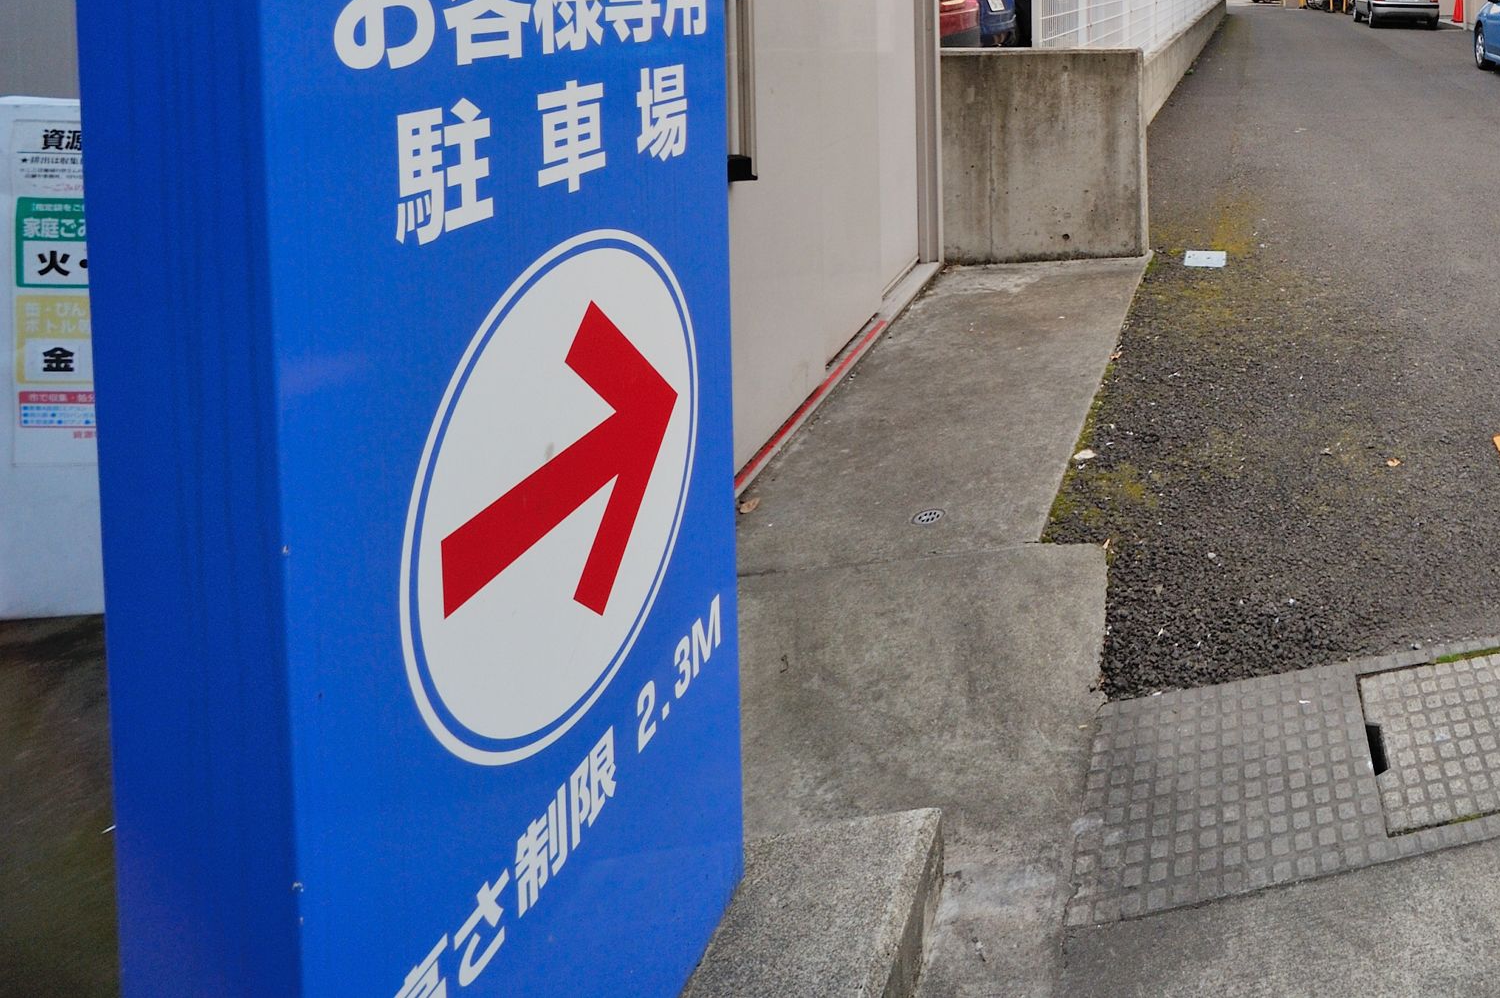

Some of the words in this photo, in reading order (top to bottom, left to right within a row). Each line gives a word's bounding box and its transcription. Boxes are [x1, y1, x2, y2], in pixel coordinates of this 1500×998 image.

[395, 64, 688, 246] 駐車場
[42, 346, 75, 372] 金
[636, 594, 722, 754] 2.3M
